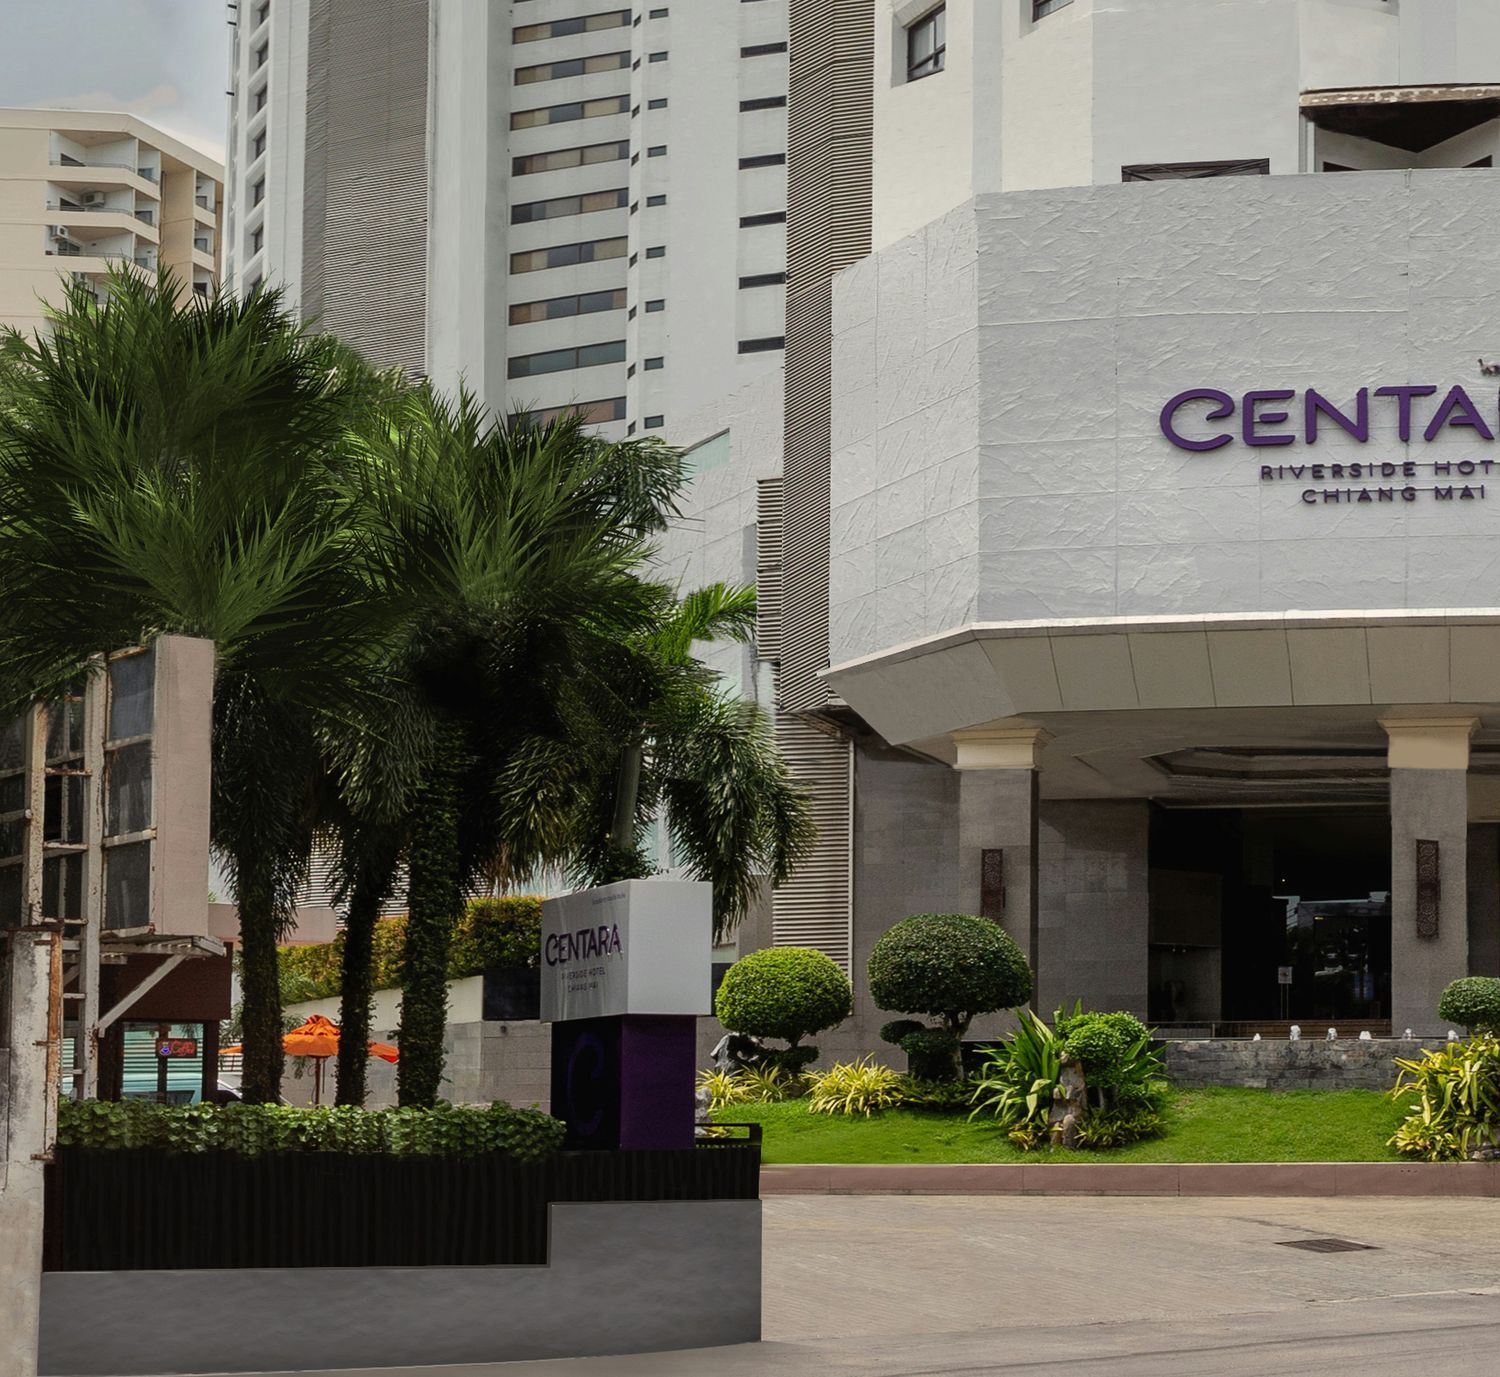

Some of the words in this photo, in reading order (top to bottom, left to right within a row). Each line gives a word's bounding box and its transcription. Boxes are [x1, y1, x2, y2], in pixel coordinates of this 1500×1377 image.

[1261, 460, 1417, 480] RIVERSIDE
[1302, 486, 1417, 504] CHIANG
[1434, 484, 1486, 501] MAI
[545, 923, 622, 966] CENTARA
